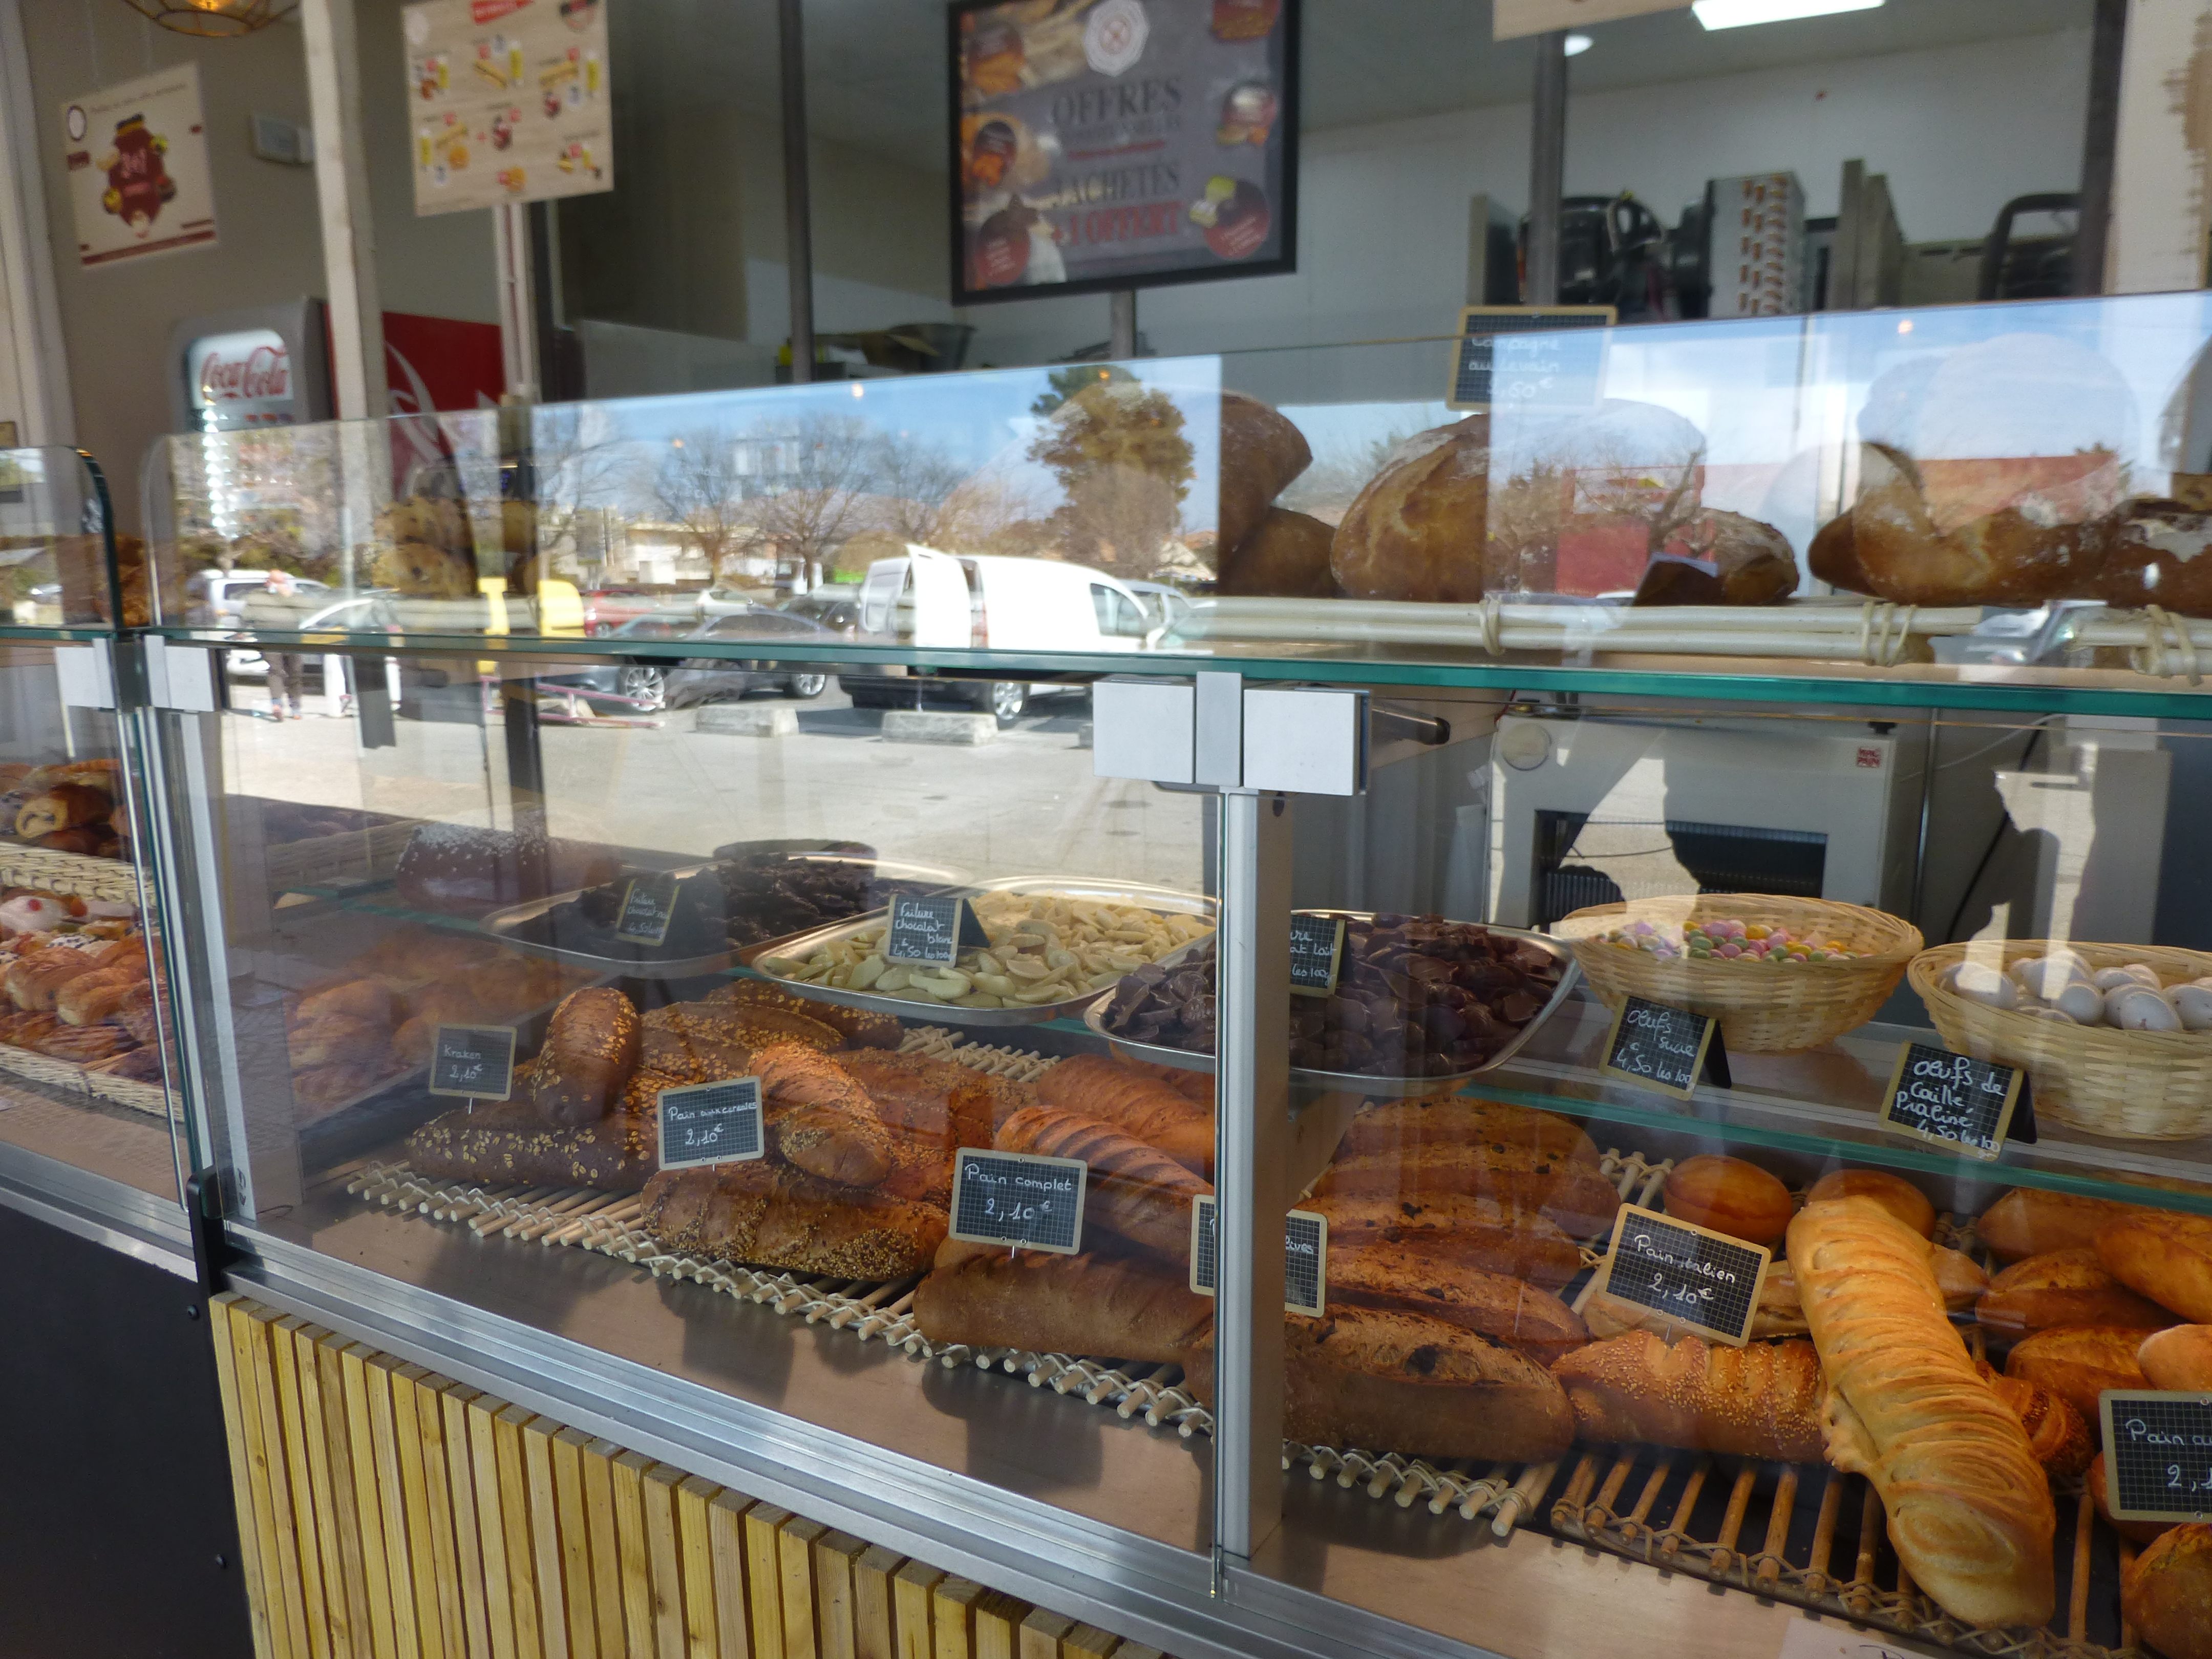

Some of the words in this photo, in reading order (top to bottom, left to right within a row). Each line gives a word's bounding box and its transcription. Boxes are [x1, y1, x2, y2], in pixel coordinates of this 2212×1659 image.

[1053, 76, 1182, 126] OFFRES
[1981, 1071, 2007, 1097] de
[668, 1106, 695, 1121] Pain
[964, 1163, 1007, 1185] Pain
[1015, 1178, 1073, 1192] complet
[1285, 1235, 1314, 1255] lives
[1634, 1234, 1674, 1265] Pain
[2125, 1418, 2185, 1447] Pain
